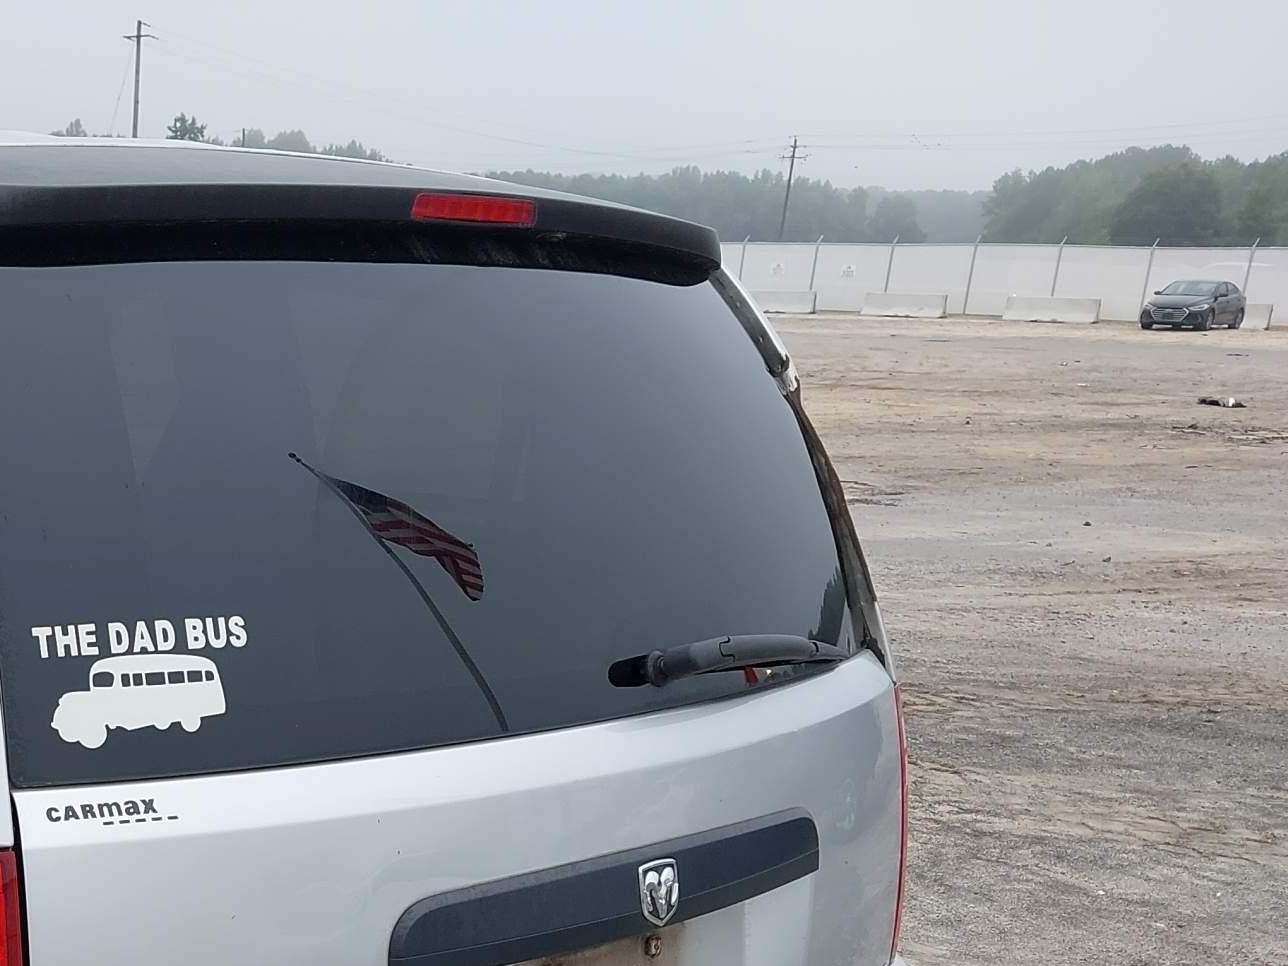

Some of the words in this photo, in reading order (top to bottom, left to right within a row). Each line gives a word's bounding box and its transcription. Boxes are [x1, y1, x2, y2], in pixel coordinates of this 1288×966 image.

[32, 624, 99, 658] THE
[108, 620, 176, 653] DAD
[185, 616, 248, 650] BUS
